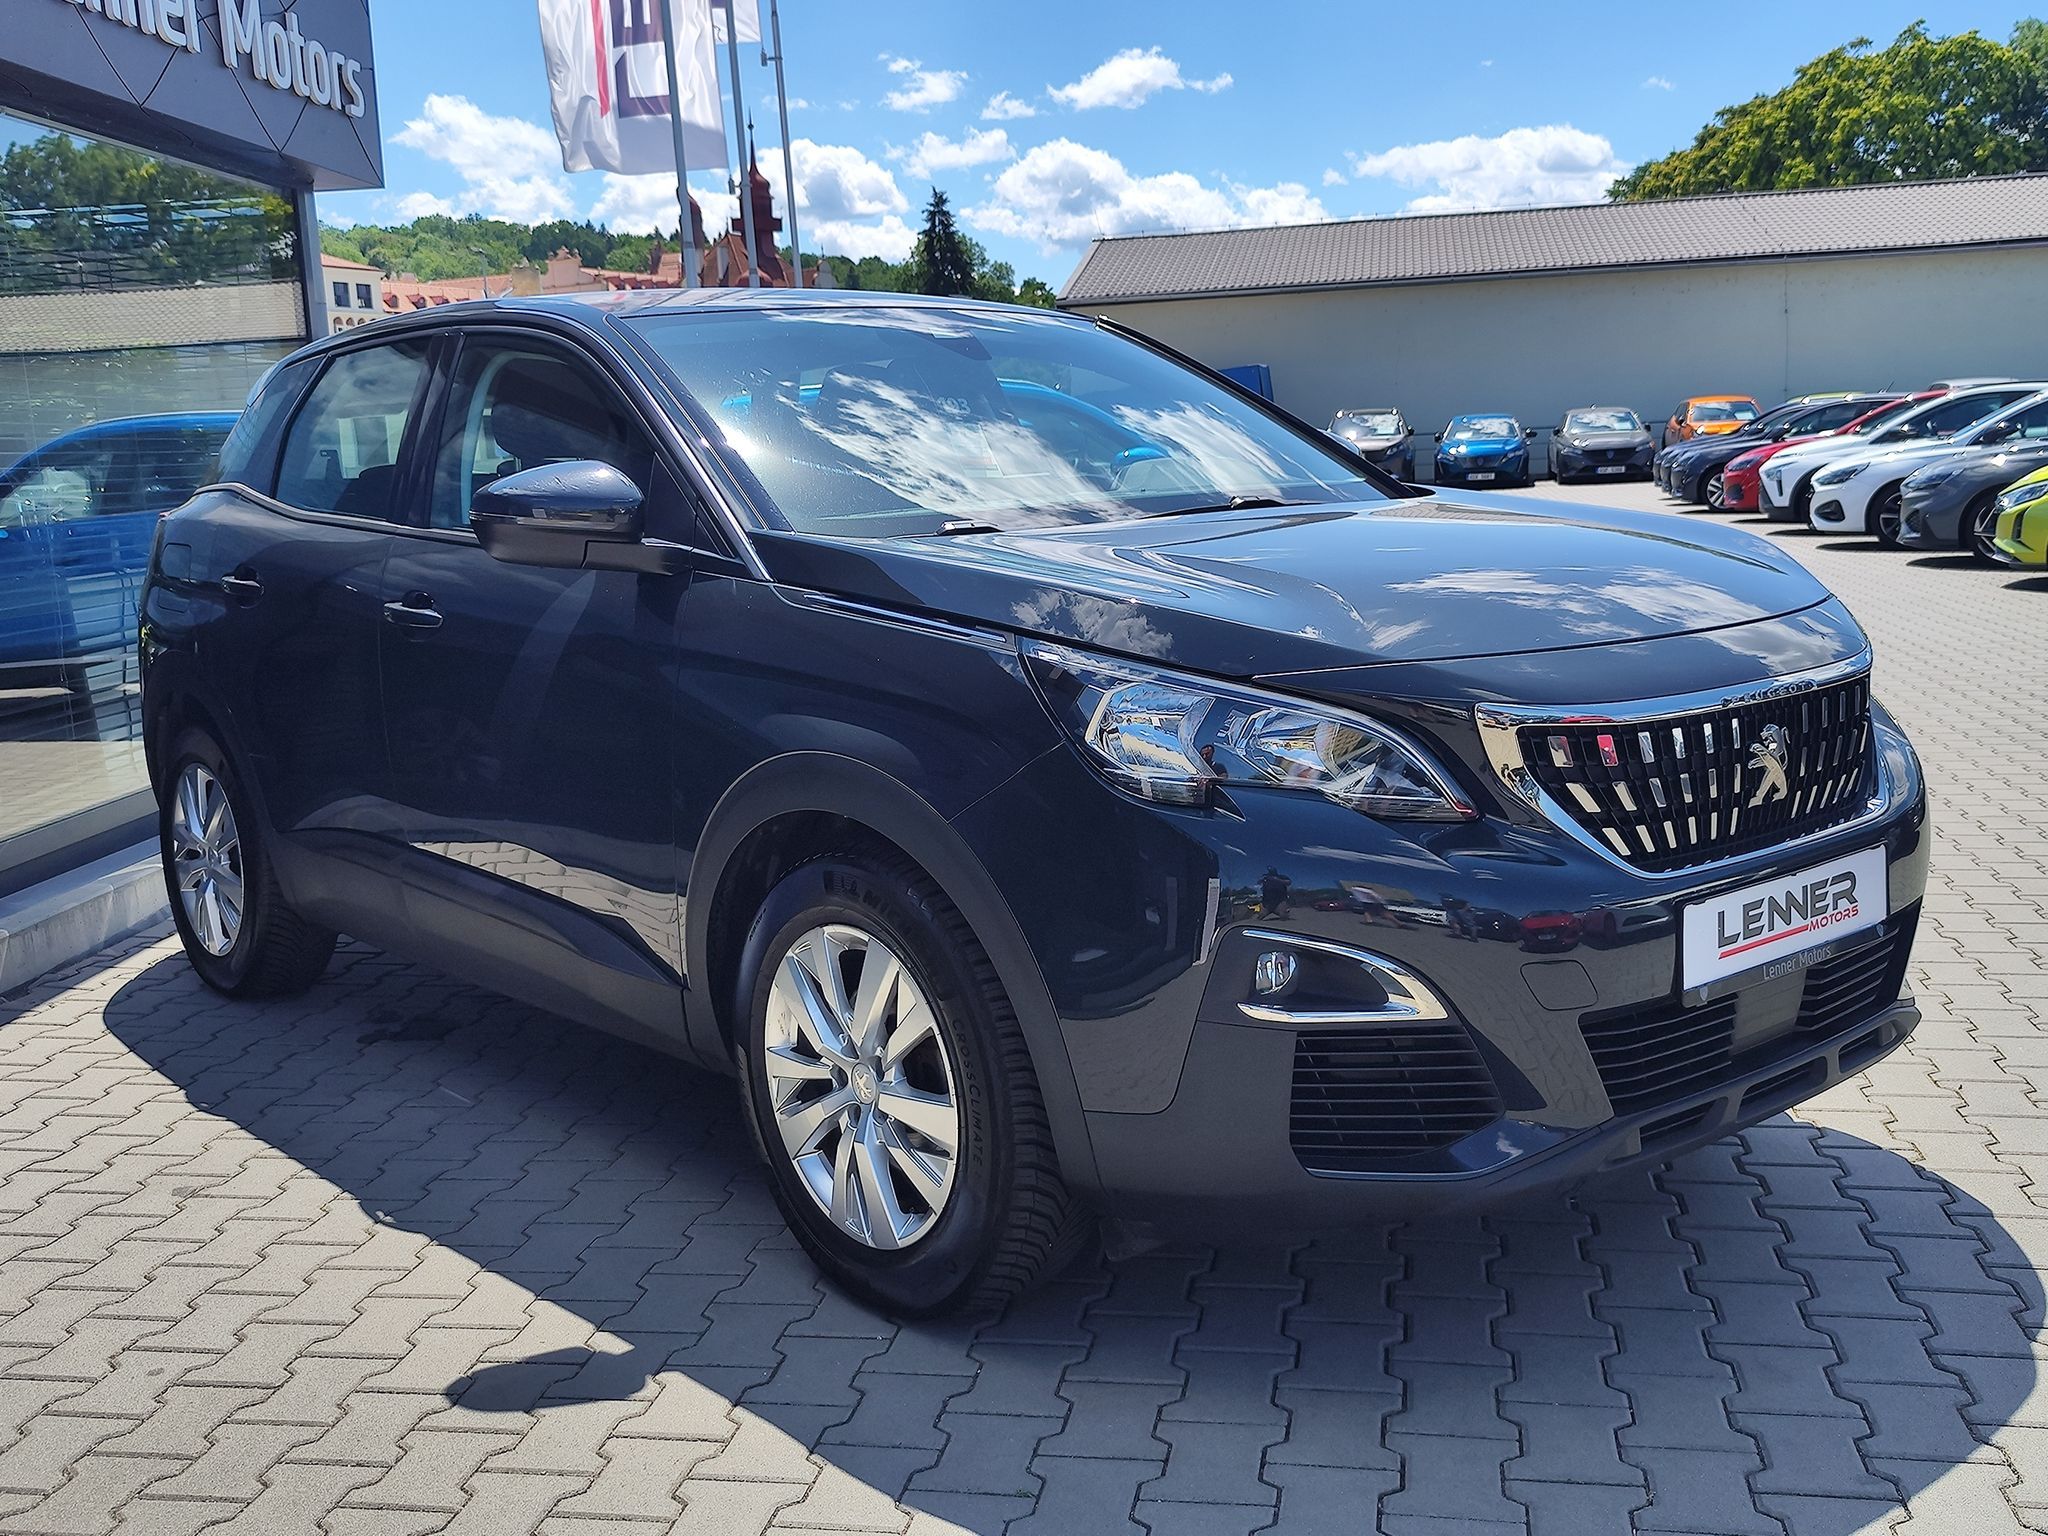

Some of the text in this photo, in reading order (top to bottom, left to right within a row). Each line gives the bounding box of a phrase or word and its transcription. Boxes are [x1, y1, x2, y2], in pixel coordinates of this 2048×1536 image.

[217, 0, 366, 118] Motors
[1717, 871, 1859, 948] LENNER
[1809, 904, 1859, 932] MOTORS
[1763, 944, 1833, 980] Lenner Motors
